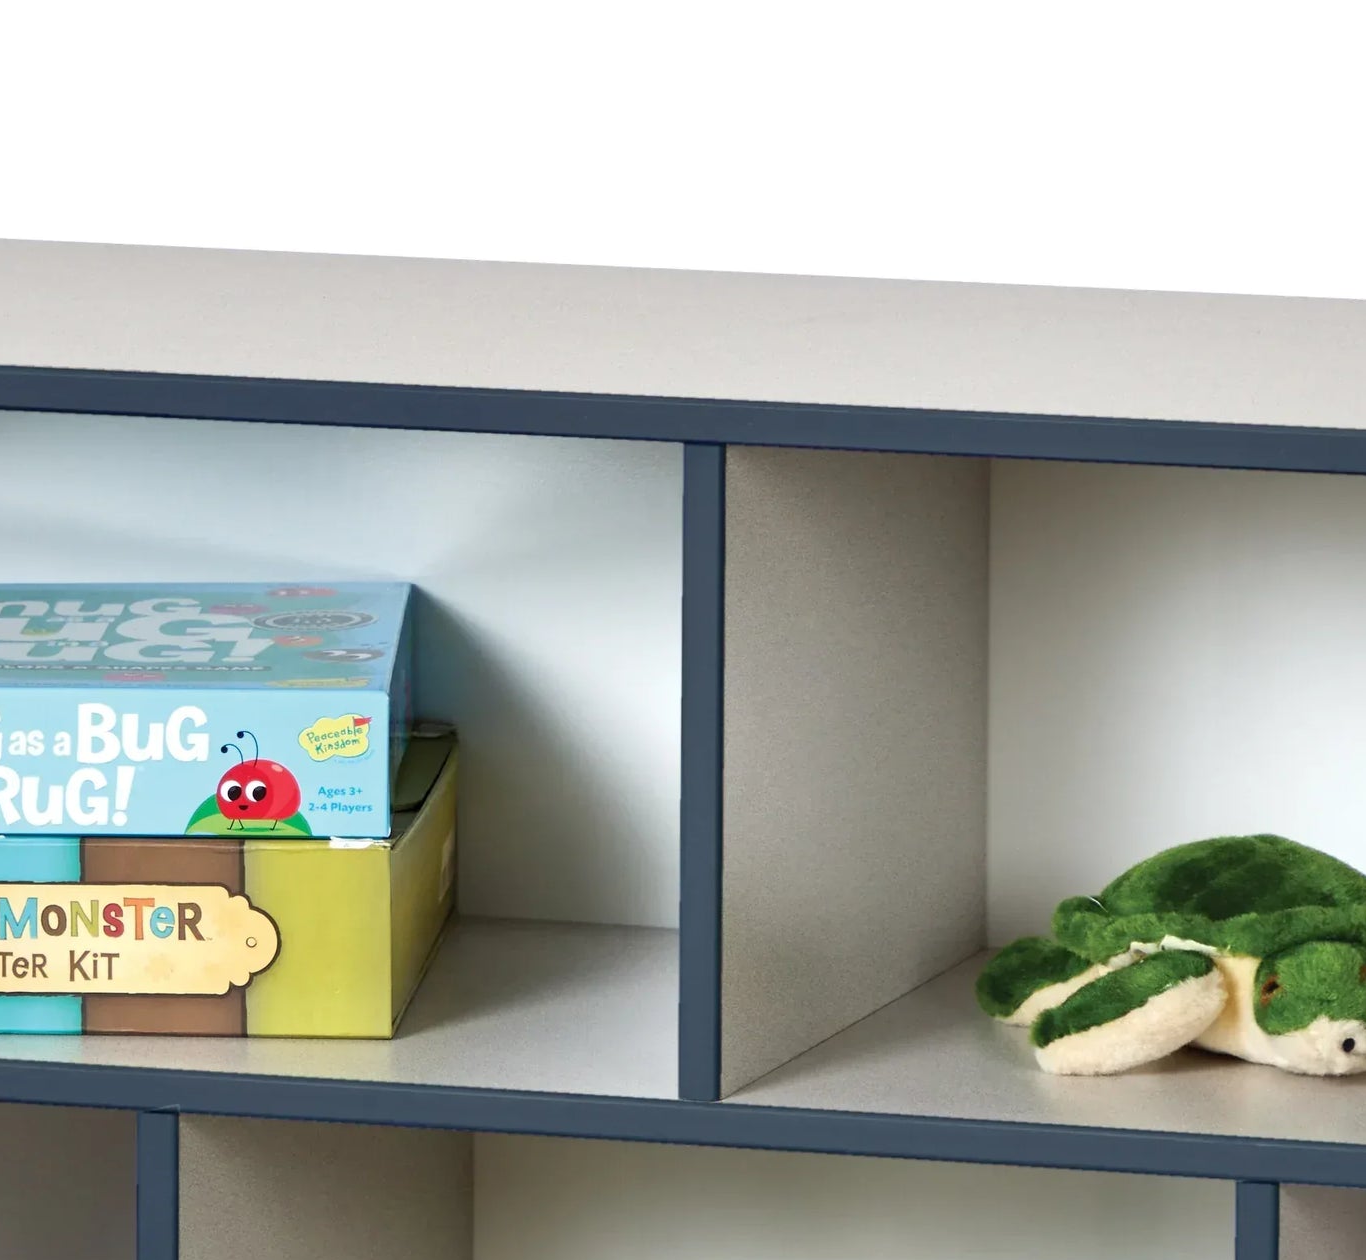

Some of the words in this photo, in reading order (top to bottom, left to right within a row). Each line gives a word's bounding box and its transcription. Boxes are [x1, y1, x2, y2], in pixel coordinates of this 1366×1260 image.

[8, 729, 46, 757] as
[53, 731, 71, 757] a
[306, 725, 364, 744] Peaceable
[314, 738, 361, 755] Kingdom
[318, 786, 346, 798] Ages
[349, 786, 363, 796] 3+
[308, 803, 328, 812] 2-4
[330, 802, 373, 814] Players
